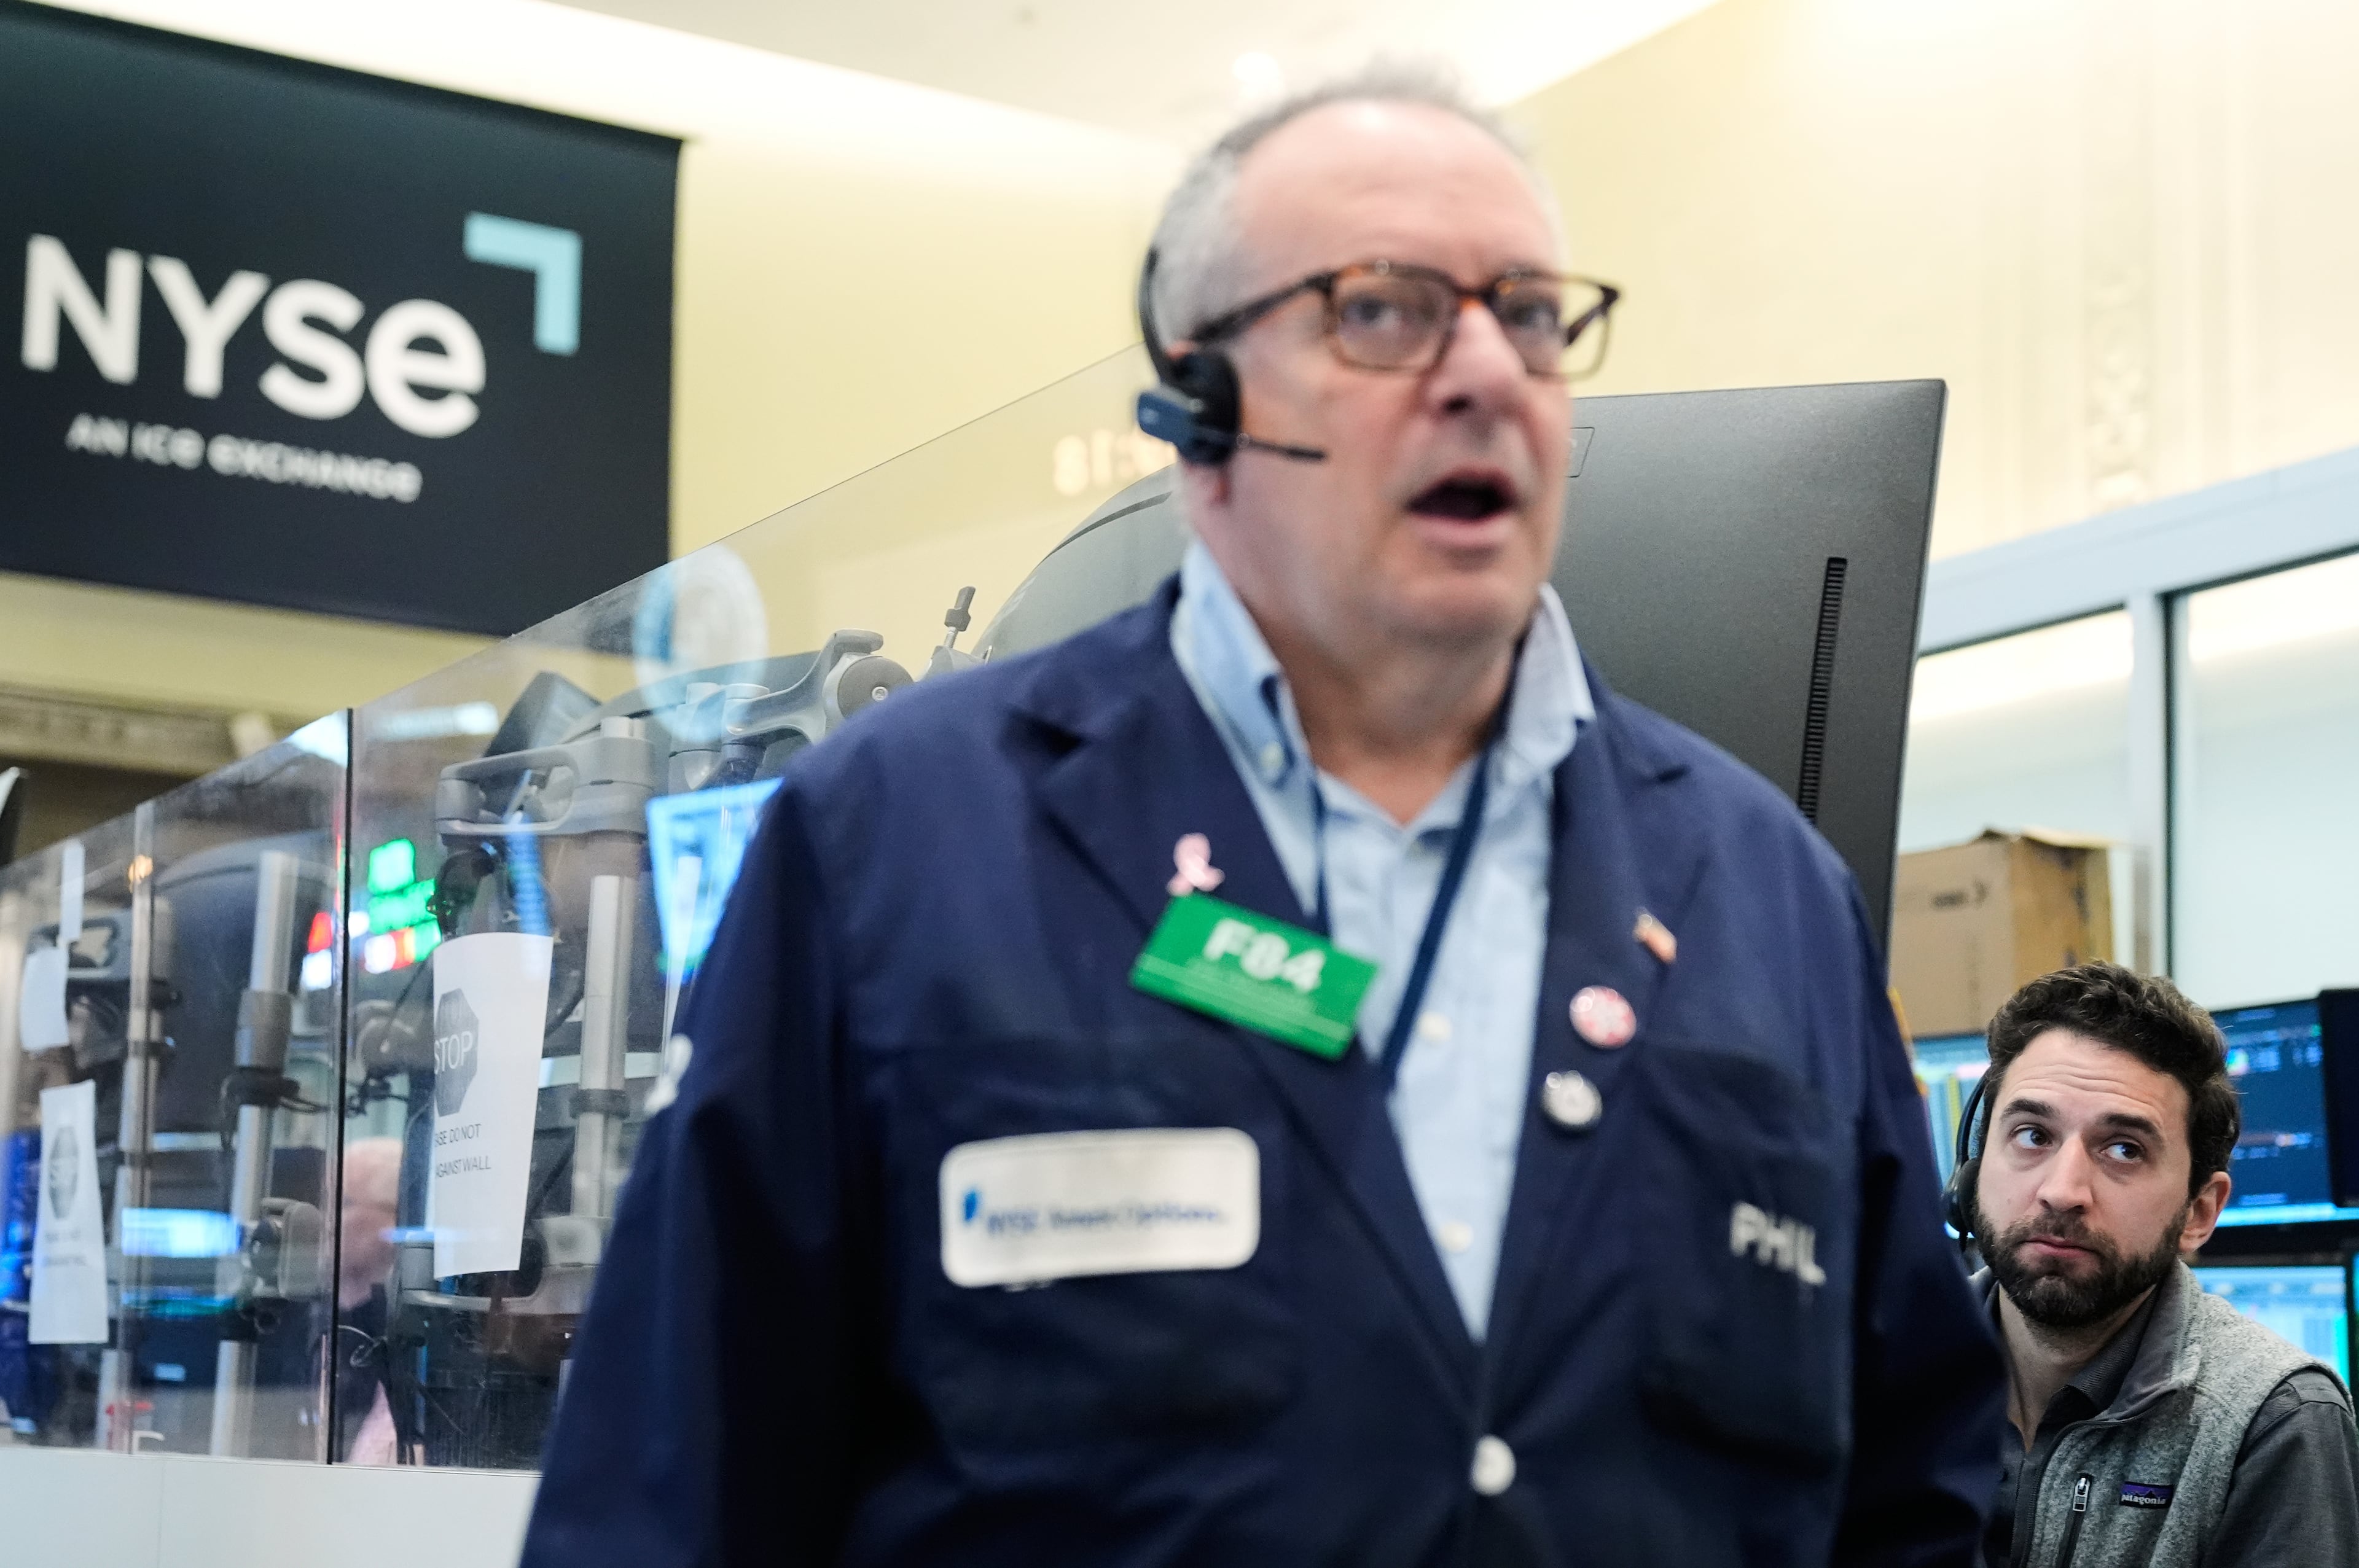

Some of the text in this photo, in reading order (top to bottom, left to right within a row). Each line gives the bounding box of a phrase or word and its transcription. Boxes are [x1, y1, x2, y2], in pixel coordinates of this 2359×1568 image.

[66, 413, 128, 458] AN
[434, 1031, 473, 1075] STOP
[449, 1128, 461, 1143] DO
[461, 1123, 481, 1140] NOT
[463, 1155, 491, 1172] WALL
[1730, 1202, 1826, 1285] PHIL
[2121, 1494, 2166, 1505] patagonia
